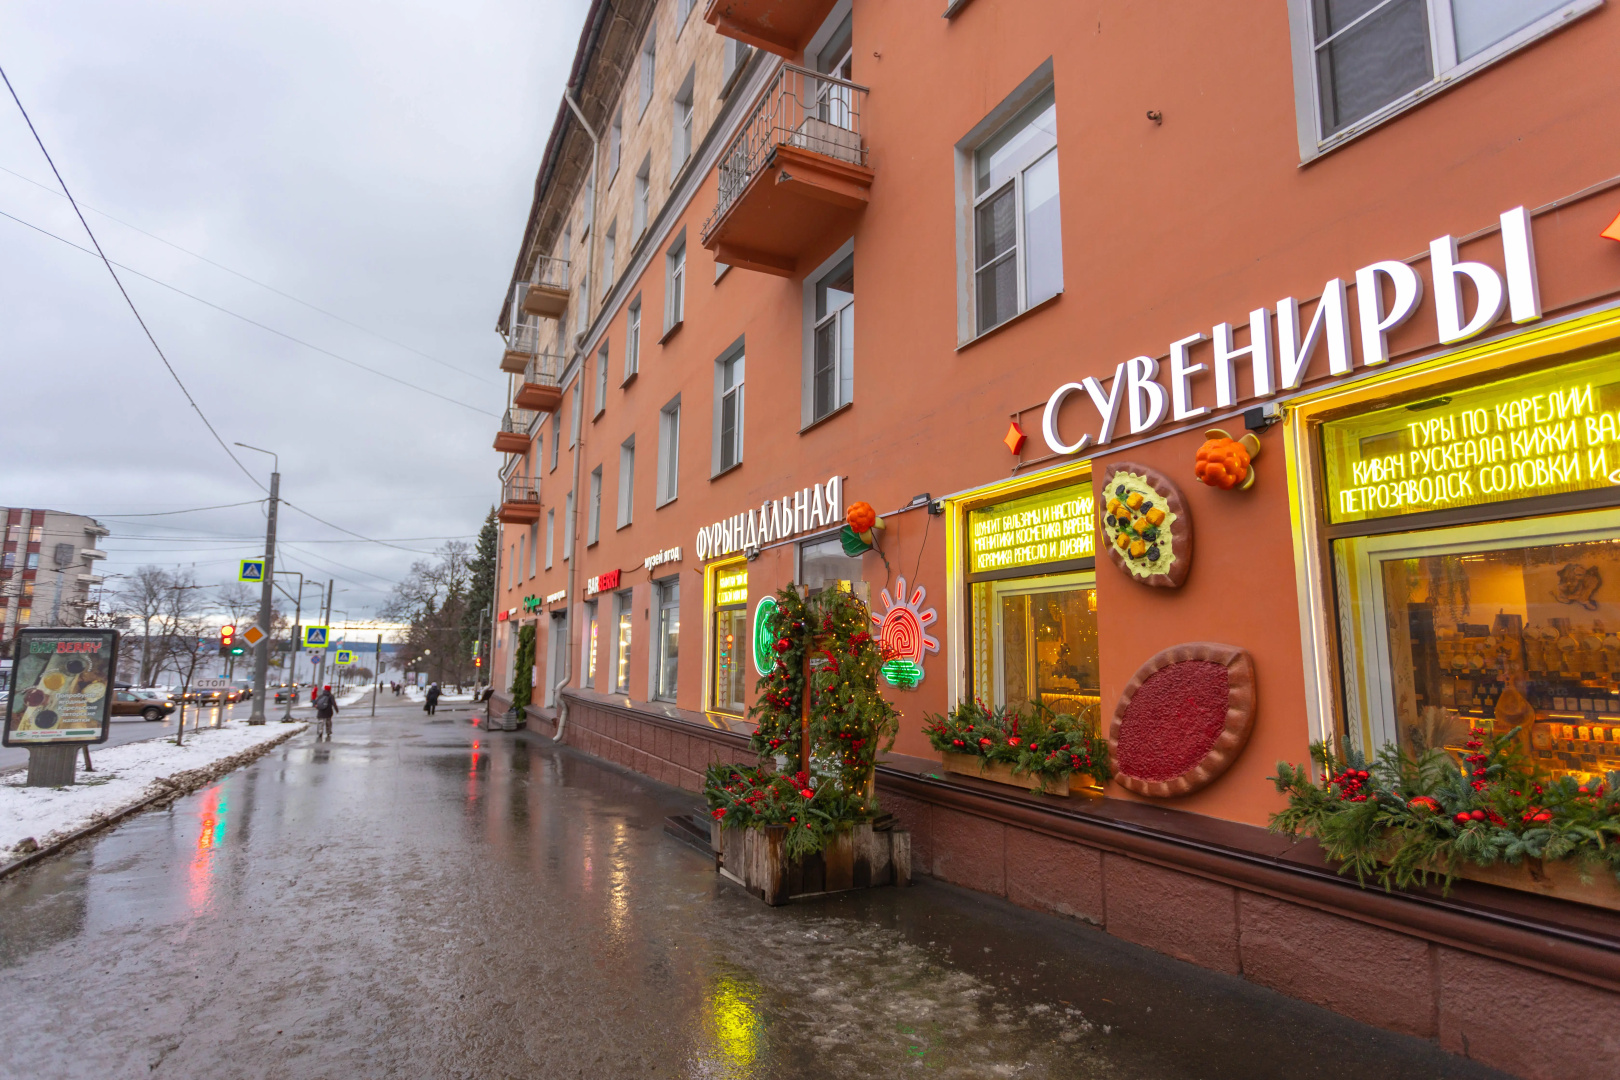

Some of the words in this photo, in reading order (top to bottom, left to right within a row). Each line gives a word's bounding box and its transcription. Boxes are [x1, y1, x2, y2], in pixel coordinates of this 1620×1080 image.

[1042, 205, 1541, 455] СУВЕНИРЫ
[1407, 416, 1455, 447] ТУРЫ
[1461, 408, 1488, 438] ПО
[1496, 383, 1594, 431] КАРЕЛИИ
[1352, 453, 1404, 486] КИВАЧ
[1410, 435, 1506, 475] РУСКЕАЛА
[1510, 419, 1579, 459] КИЖИ
[1585, 410, 1620, 446] ВА
[1340, 471, 1474, 514] ПЕТРОЗАВОДСК
[1479, 451, 1581, 494] СОЛОВКИ
[1588, 447, 1608, 478] И
[696, 475, 842, 561] ФУРЫНДАЛЬНАЯ
[974, 517, 1002, 537] ШУНГИТ
[1002, 511, 1041, 531] БАЛЬЗАМЫ
[1043, 507, 1050, 523] И
[974, 530, 1015, 552] МАГНИТИКИ
[1016, 522, 1061, 545] КОСМЕТИКА
[978, 547, 1013, 569] КЕРАМИКА
[1014, 543, 1048, 564] РЕМЕСЛО
[1049, 541, 1057, 557] И
[1058, 533, 1094, 558] ДИЗАЙН
[644, 549, 663, 571] музей
[663, 546, 681, 562] ягод
[588, 569, 620, 595] BARBERRY
[30, 642, 102, 653] BARBERRY
[197, 679, 226, 687] СТОП
